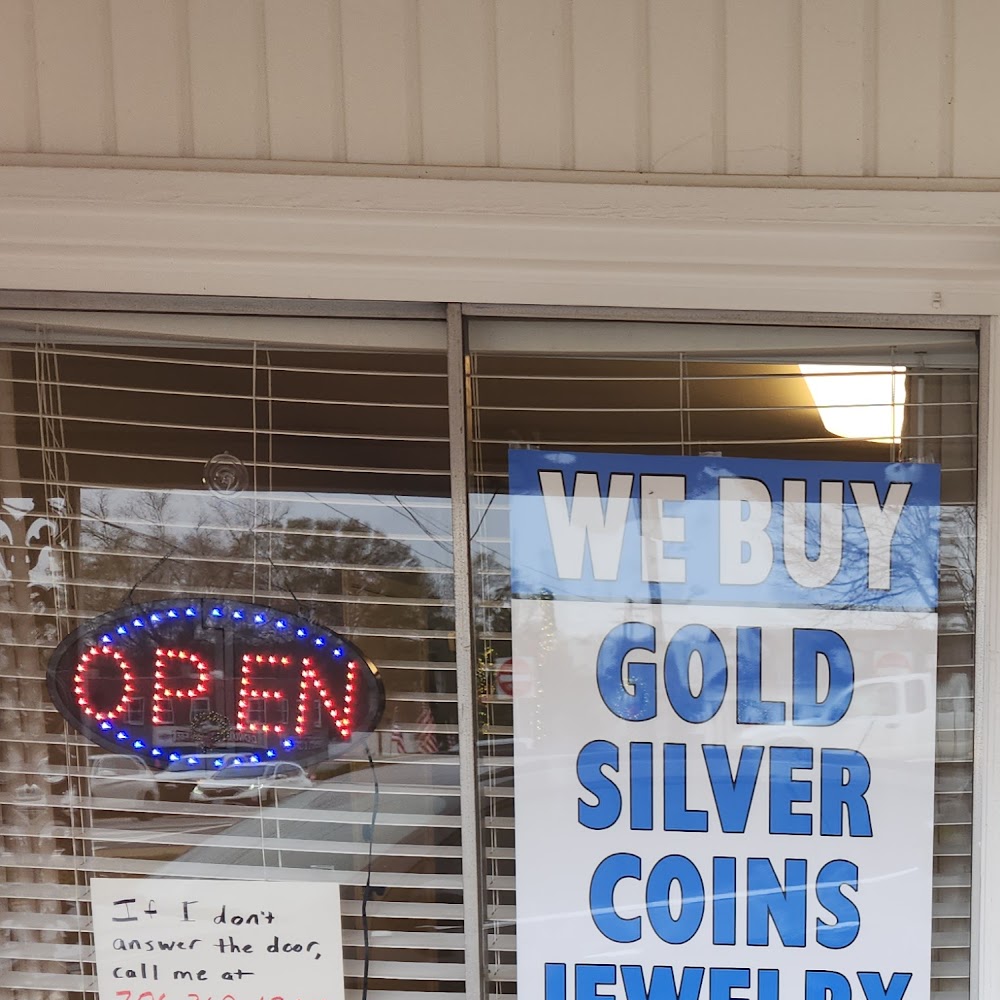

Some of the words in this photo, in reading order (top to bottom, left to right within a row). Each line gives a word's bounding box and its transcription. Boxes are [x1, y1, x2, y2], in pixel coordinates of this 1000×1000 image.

[538, 470, 687, 584] WE
[717, 475, 912, 591] BUY
[74, 643, 357, 738] OPEN
[596, 621, 855, 727] GOLD
[576, 739, 873, 838] SILVER
[112, 898, 157, 922] If
[181, 900, 198, 922] I
[213, 905, 275, 925] don't
[112, 937, 202, 952] answer
[213, 936, 253, 953] the
[267, 936, 321, 960] door,
[589, 852, 860, 949] COINS
[113, 963, 158, 980] call
[174, 969, 208, 980] me
[221, 968, 255, 980] at
